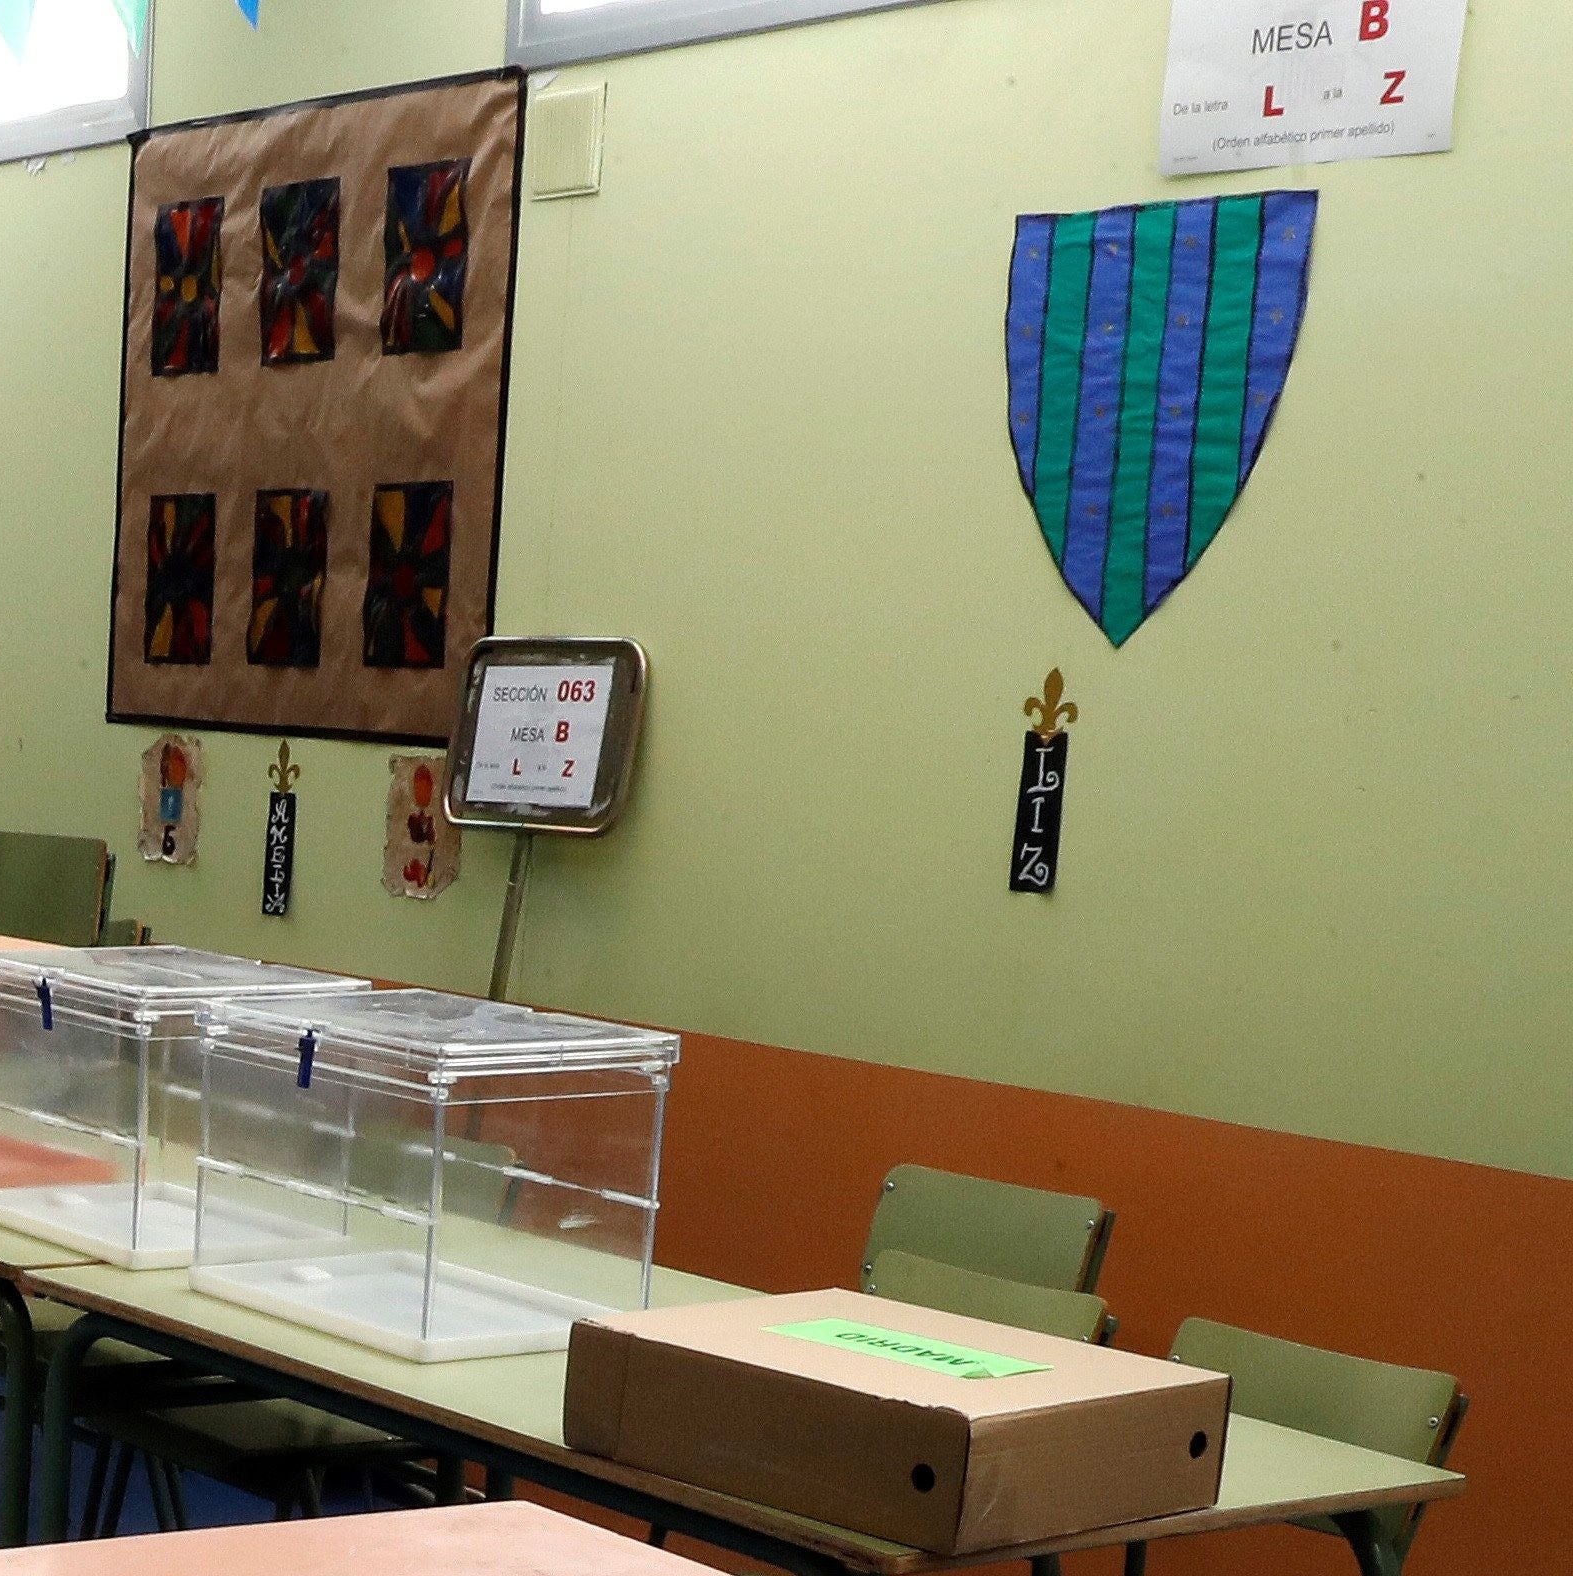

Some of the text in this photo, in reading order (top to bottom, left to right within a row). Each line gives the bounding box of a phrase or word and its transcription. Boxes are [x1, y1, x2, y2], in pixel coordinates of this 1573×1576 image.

[1252, 0, 1390, 54] MESA B
[1262, 85, 1285, 118] L
[1380, 70, 1406, 105] Z
[493, 680, 596, 703] SECCIÓN 063
[510, 720, 570, 743] MESA B
[512, 758, 522, 776] L
[561, 759, 576, 778] Z
[835, 1332, 973, 1366] MADRID
